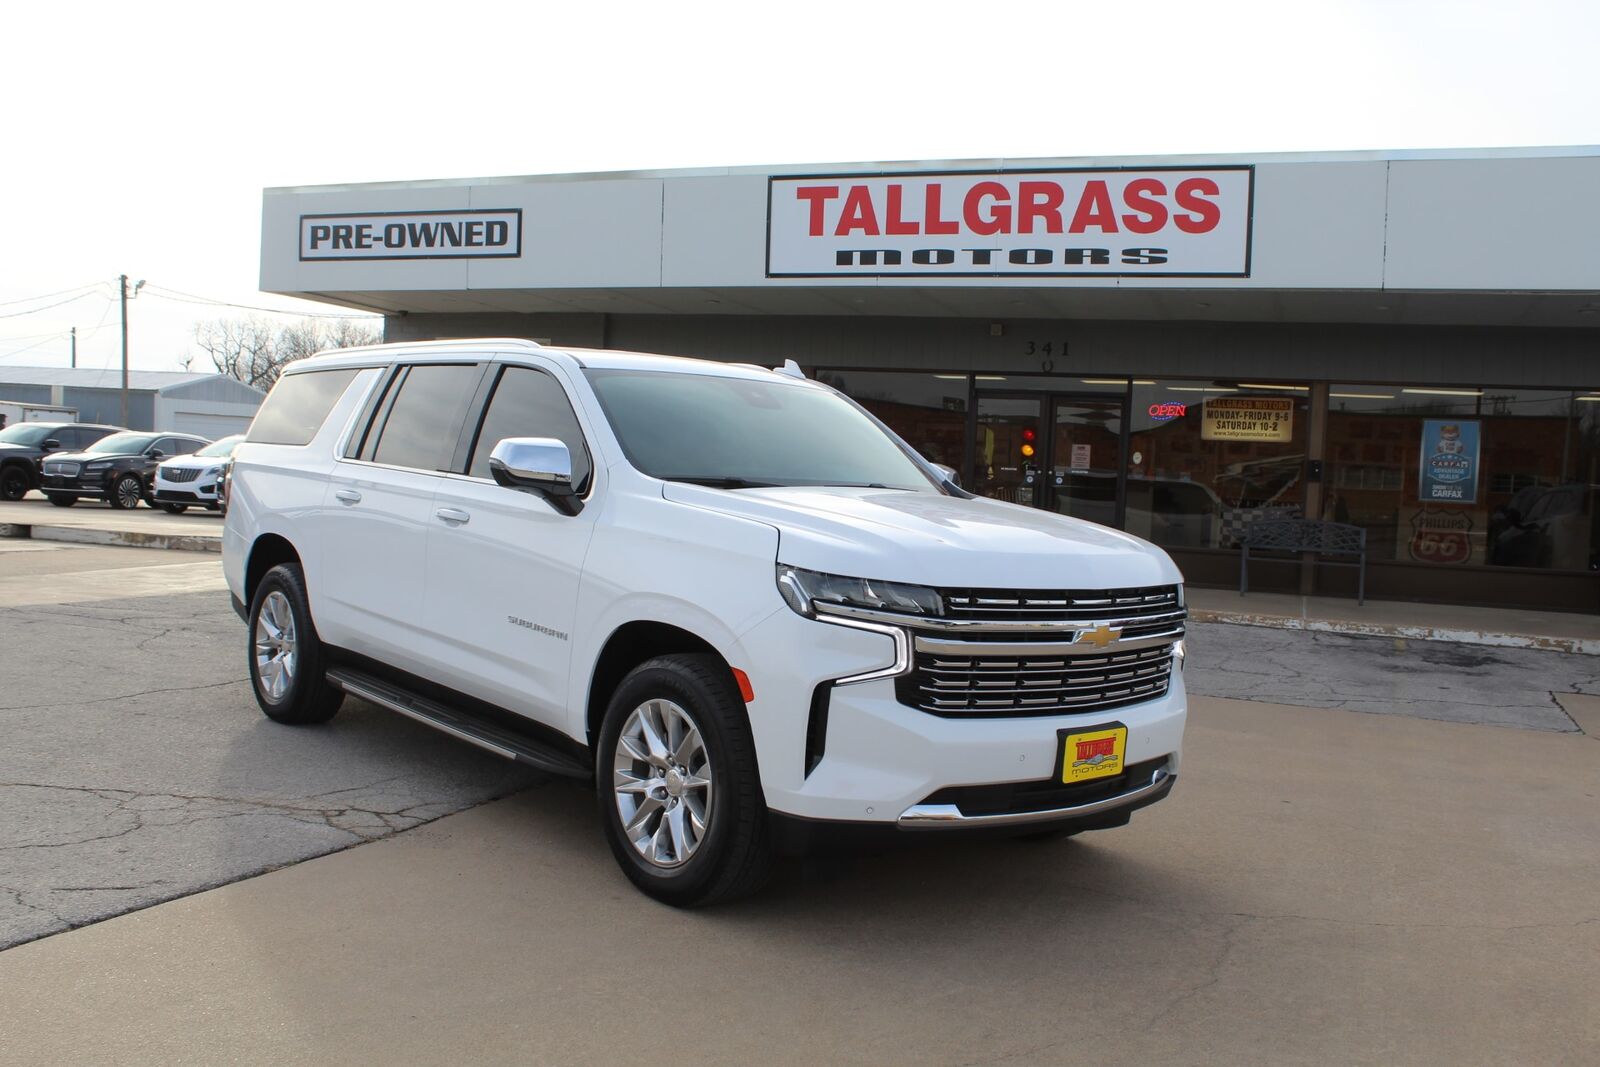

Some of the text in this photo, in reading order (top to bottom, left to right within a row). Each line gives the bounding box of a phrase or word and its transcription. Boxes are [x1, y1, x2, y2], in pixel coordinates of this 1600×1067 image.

[797, 178, 1221, 236] TALLGRASS
[310, 220, 508, 249] PRE-OWNED
[835, 248, 1168, 266] MOTORS
[1148, 404, 1186, 417] OPEN
[1256, 401, 1289, 410] MOTORS
[1207, 410, 1289, 421] MONDAY-FRIDAY 9-6
[1216, 420, 1278, 431] SATURDAY 10-2
[1432, 489, 1463, 498] CARFAX
[1419, 517, 1465, 529] PHILLIPS
[1420, 533, 1458, 556] 66
[507, 615, 568, 641] SUBURBAN
[1072, 762, 1118, 774] MOTORS
